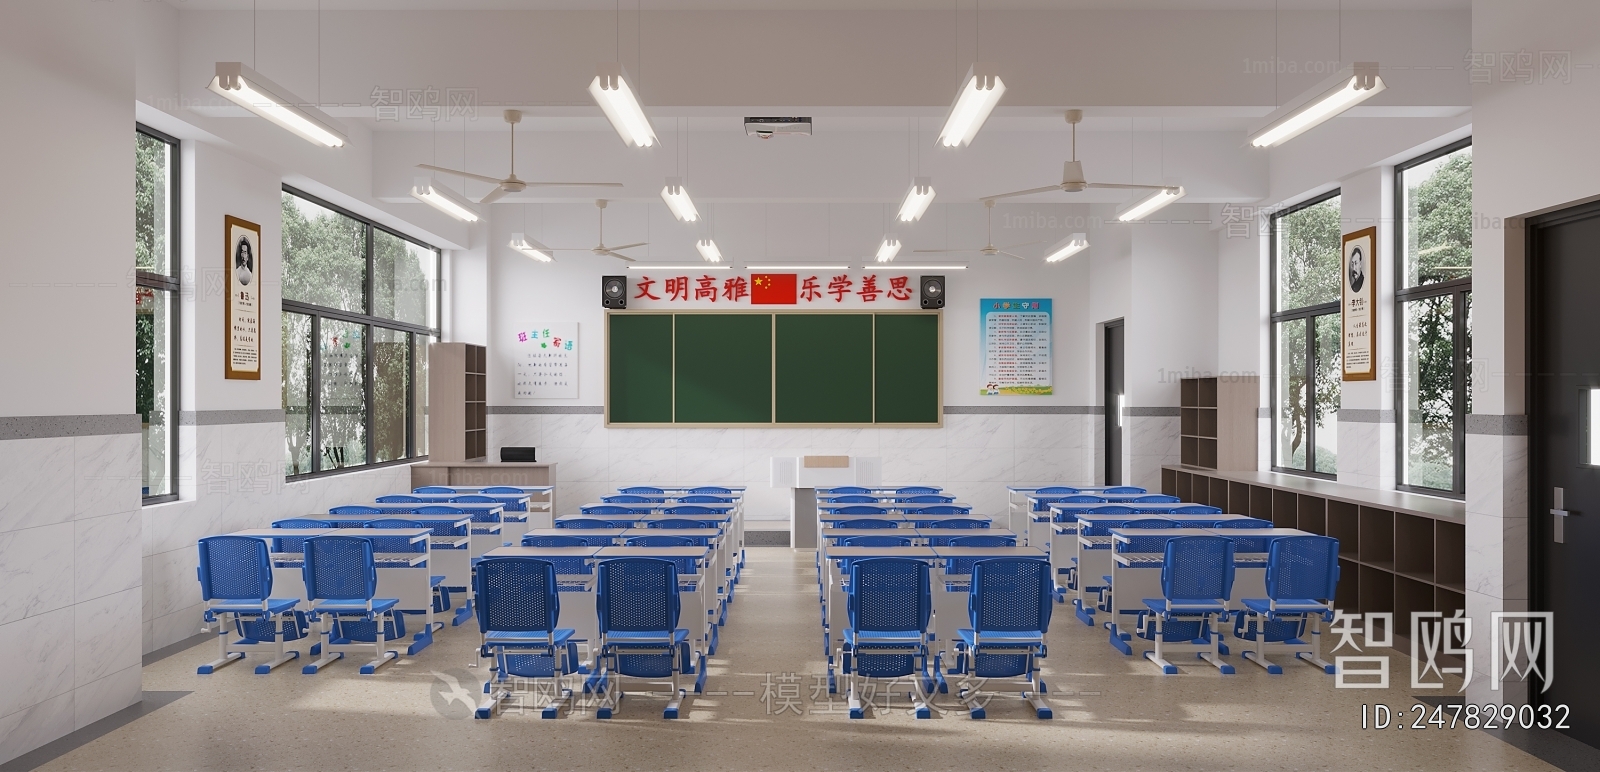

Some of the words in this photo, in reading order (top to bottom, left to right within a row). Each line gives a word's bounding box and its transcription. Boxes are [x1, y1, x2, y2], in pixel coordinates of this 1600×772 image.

[633, 274, 750, 304] 文明高雅
[799, 274, 913, 303] 乐学善思
